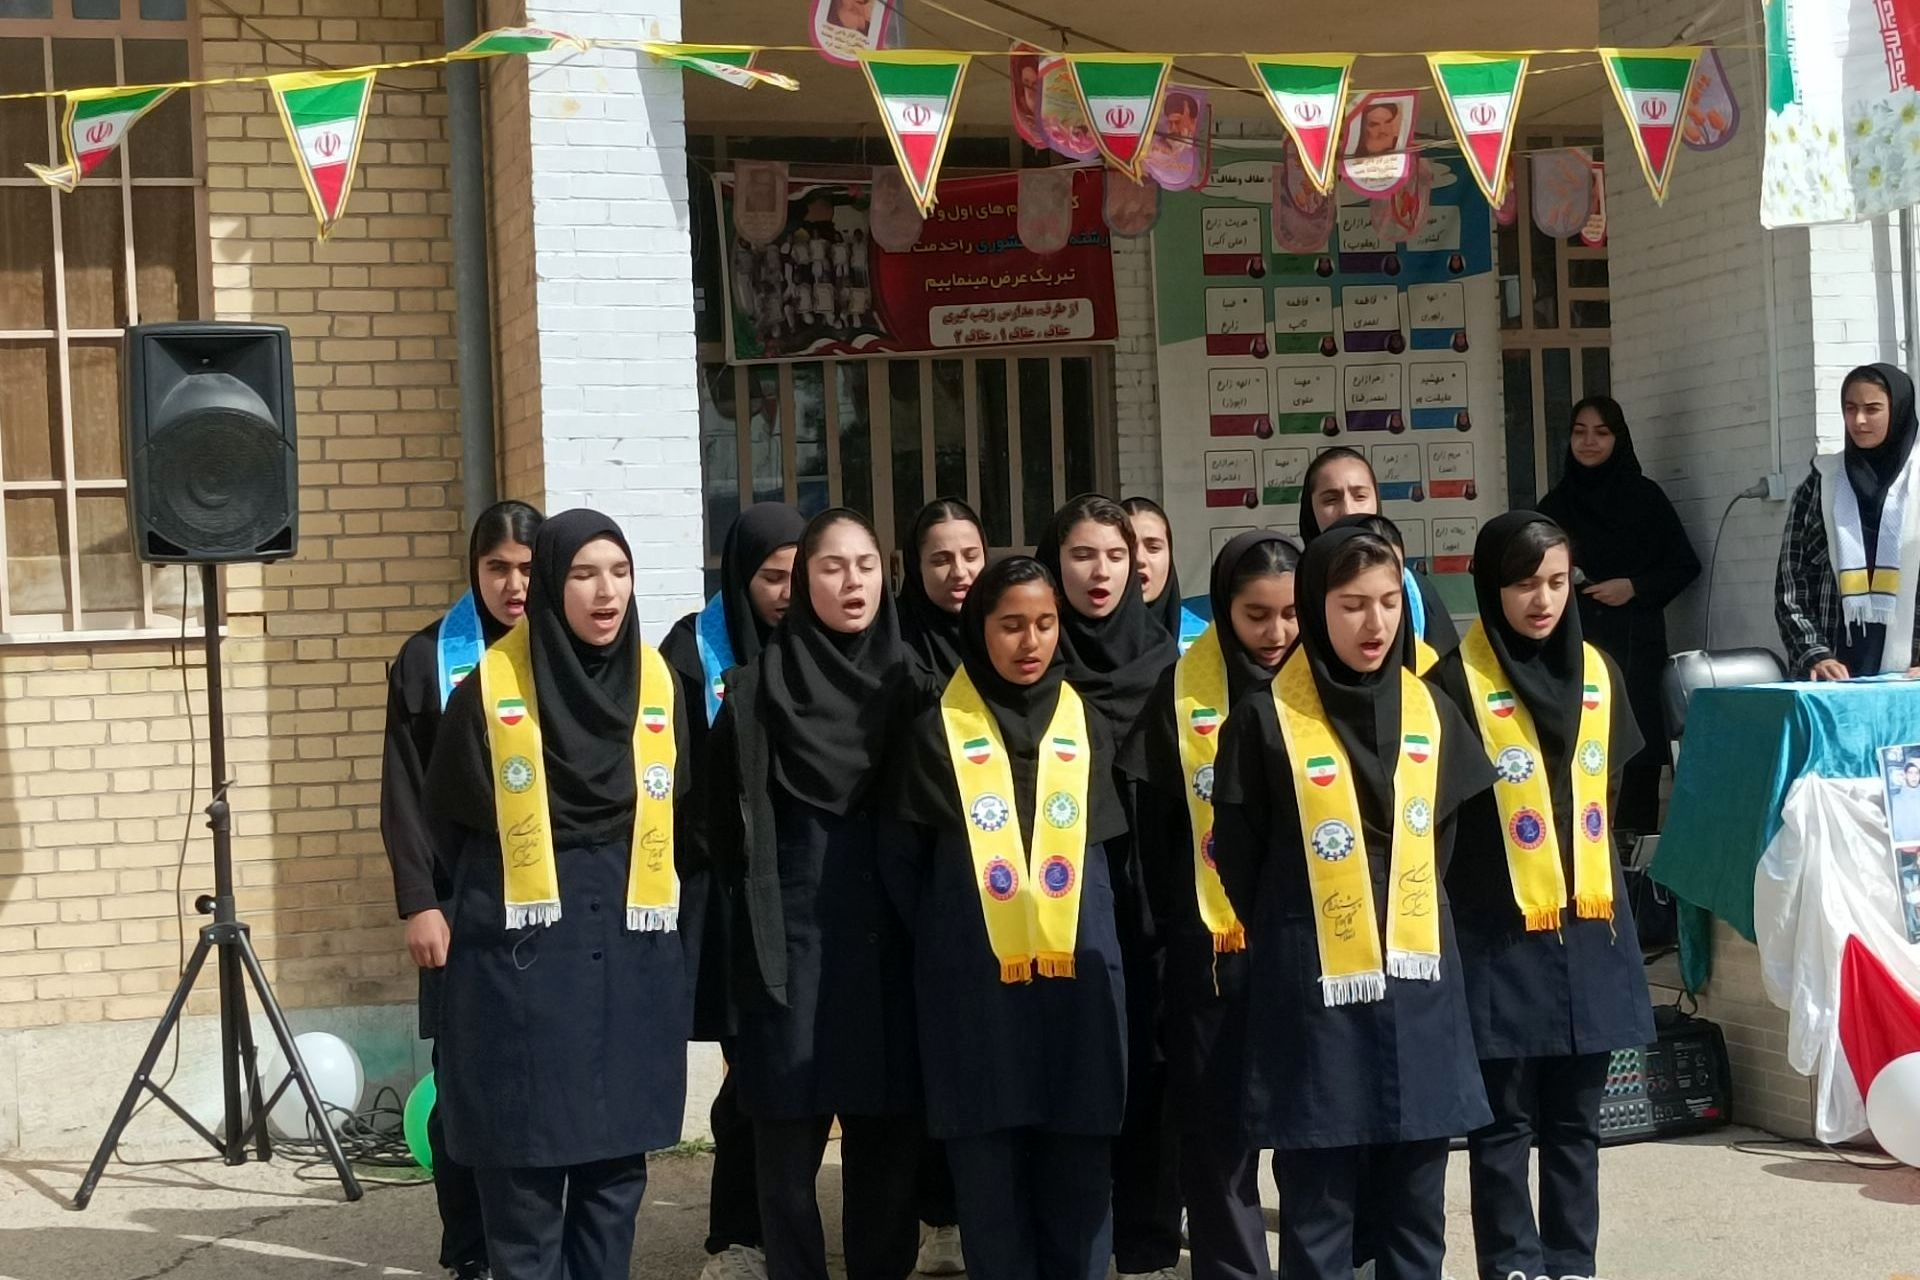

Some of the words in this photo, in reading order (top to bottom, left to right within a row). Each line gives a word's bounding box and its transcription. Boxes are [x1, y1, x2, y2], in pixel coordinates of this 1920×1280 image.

[947, 204, 973, 222] اول
[976, 205, 1004, 220] های
[976, 235, 1025, 255] شوری
[924, 273, 988, 292] مینماییم
[990, 272, 1027, 289] عرض
[1030, 267, 1076, 285] تبریک
[1067, 302, 1079, 318] از
[1286, 295, 1309, 307] فاطمه
[997, 303, 1034, 322] مدارس
